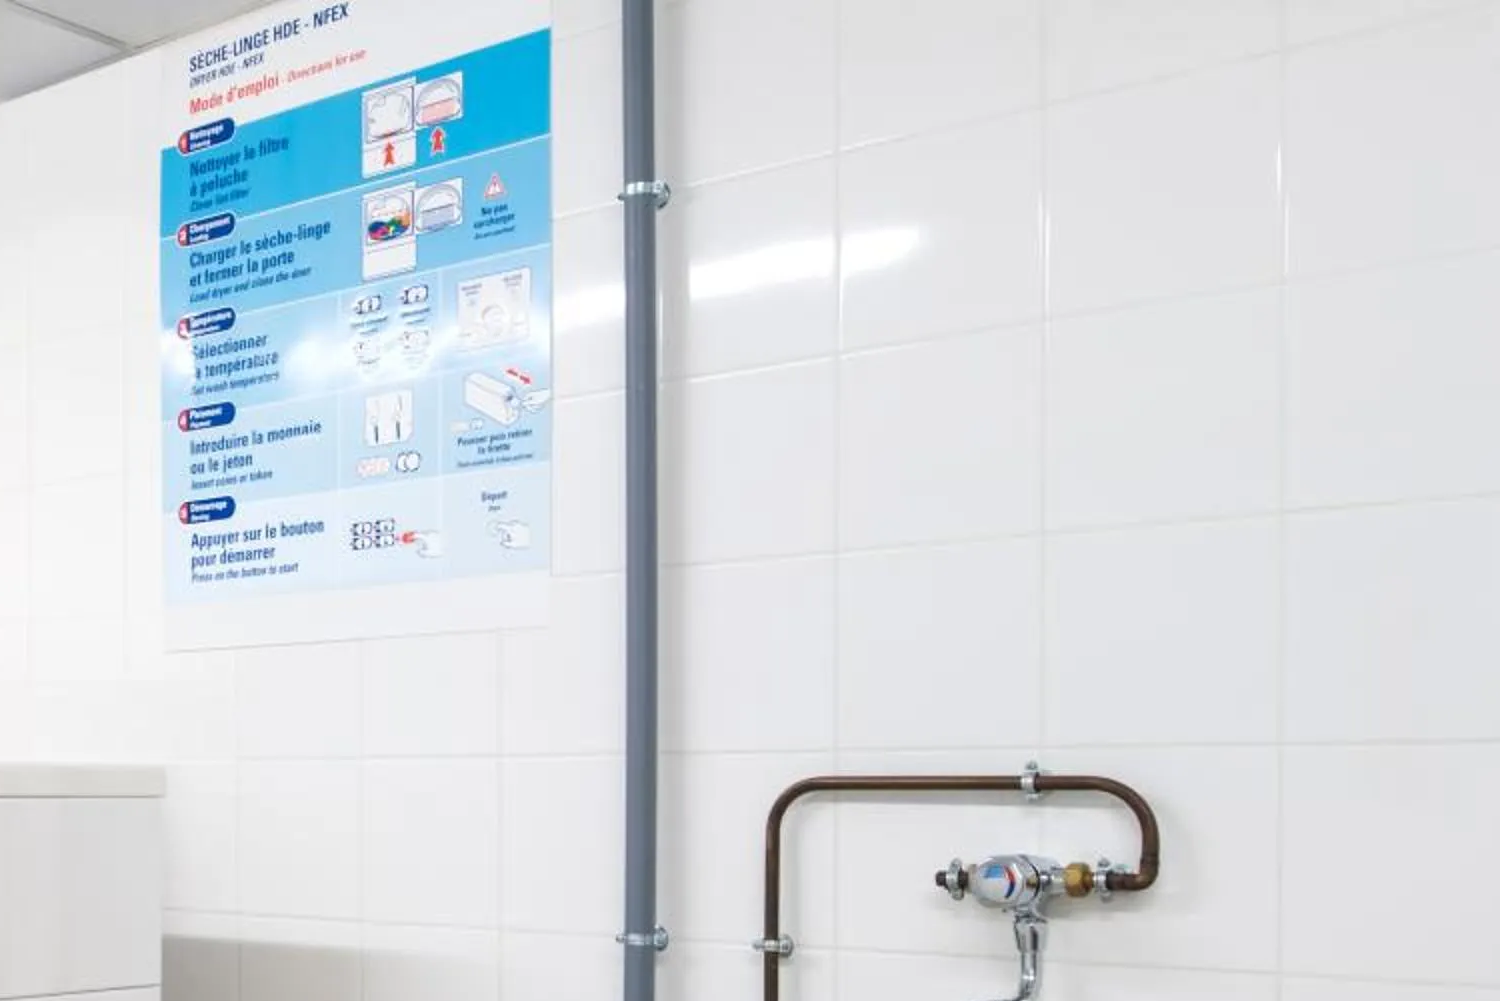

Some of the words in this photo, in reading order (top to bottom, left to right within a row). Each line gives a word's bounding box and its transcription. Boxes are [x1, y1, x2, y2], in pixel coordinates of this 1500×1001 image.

[273, 18, 300, 42] HDE
[313, 2, 350, 29] NFEX
[190, 93, 223, 114] Mode
[190, 151, 241, 176] Nettoyer
[244, 145, 256, 160] le
[259, 137, 289, 156] filtre
[201, 169, 249, 197] peluche
[190, 245, 237, 268] Charger
[240, 241, 251, 254] le
[255, 222, 331, 249] sèche-linge
[190, 273, 201, 287] et
[205, 263, 244, 284] fermer
[247, 259, 259, 273] la
[262, 251, 294, 276] porte
[190, 433, 249, 455] Introduire
[251, 430, 264, 444] la
[267, 420, 322, 443] monnaie
[190, 462, 205, 475] ou
[208, 457, 219, 473] le
[222, 453, 253, 473] jeton
[191, 530, 239, 550] Appuyer
[243, 527, 261, 542] sur
[265, 523, 276, 539] le
[280, 519, 324, 538] bouton
[191, 552, 216, 570] pour
